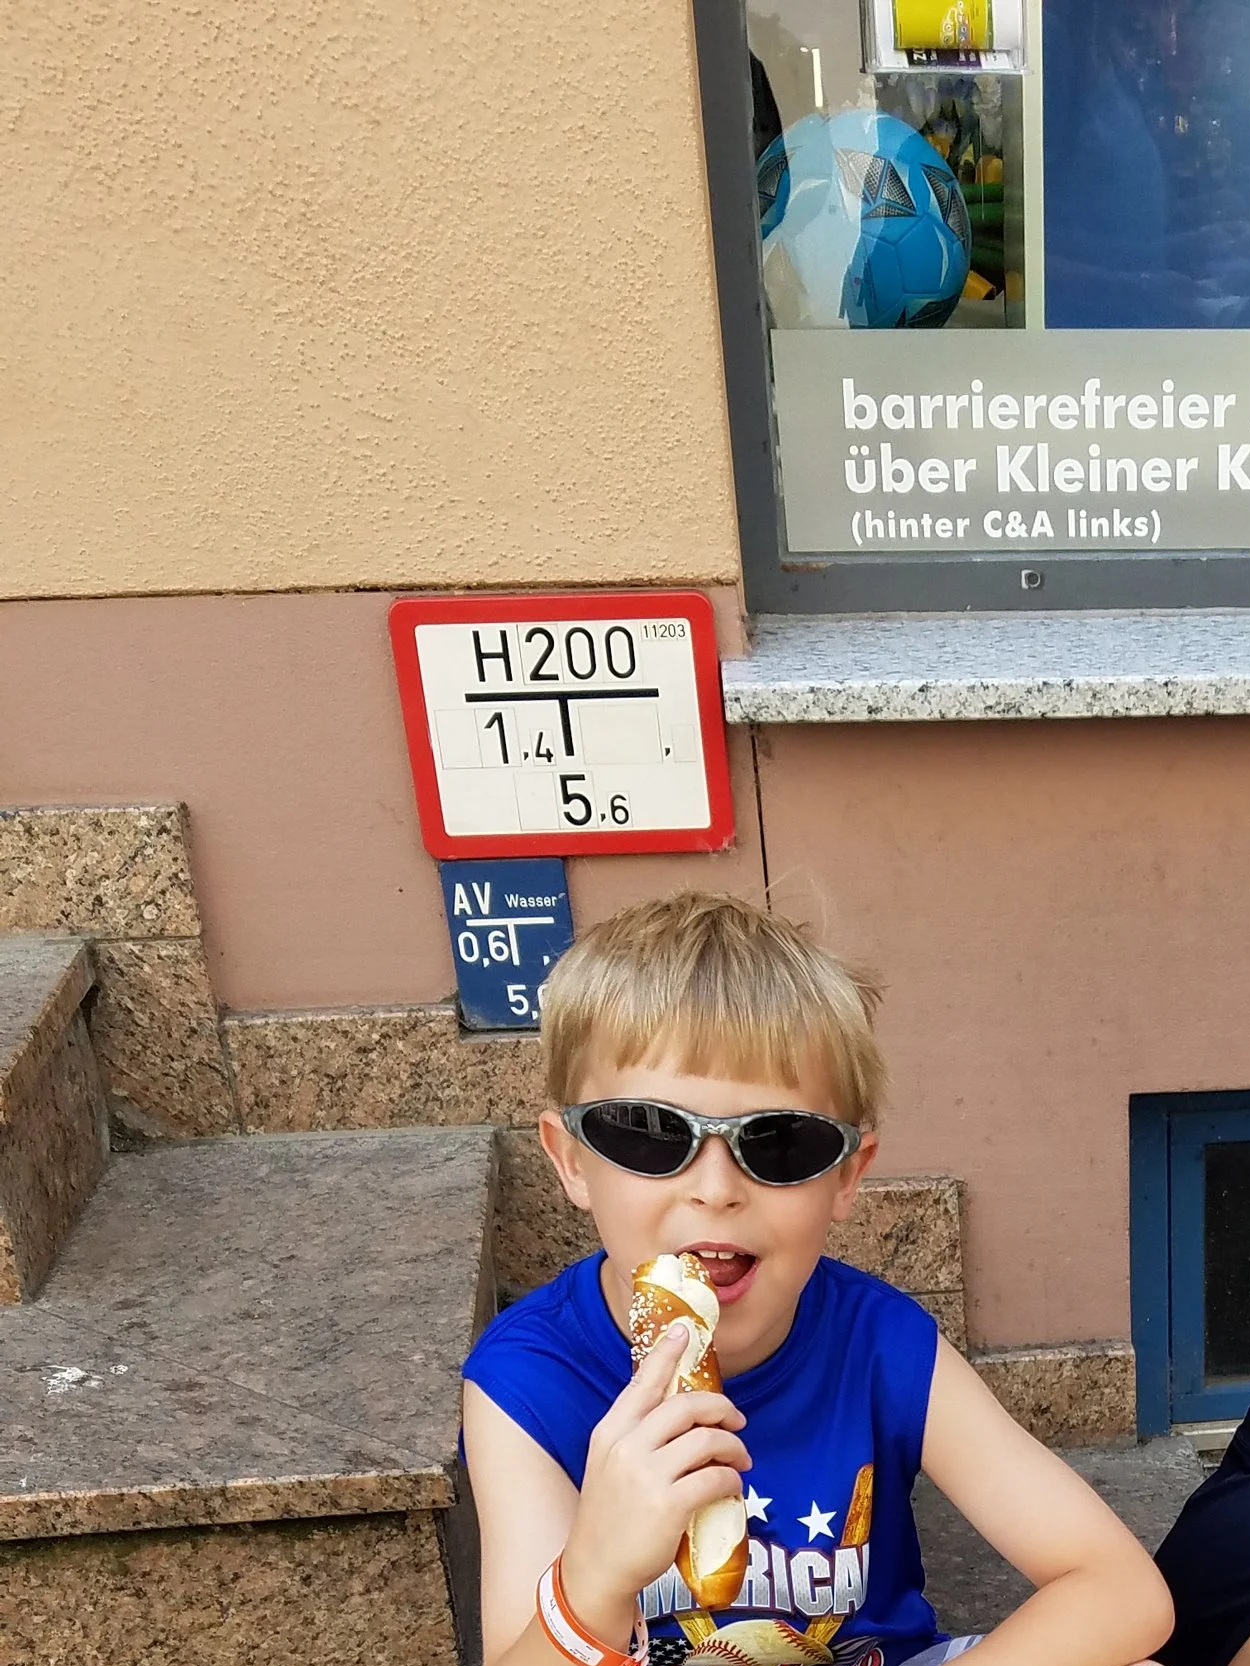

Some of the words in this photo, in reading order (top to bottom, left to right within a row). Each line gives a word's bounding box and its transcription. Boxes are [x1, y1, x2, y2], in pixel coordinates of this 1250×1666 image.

[842, 378, 1236, 429] barrierefreier
[845, 443, 977, 493] über
[997, 443, 1199, 492] Kleiner
[851, 509, 970, 546] (hinter
[983, 510, 1055, 538] C&A
[1067, 508, 1161, 544] links)
[642, 624, 686, 639] 11203
[472, 626, 637, 683] H200
[453, 882, 491, 915] AV
[504, 893, 558, 909] Wasser
[457, 930, 509, 968] 0,6
